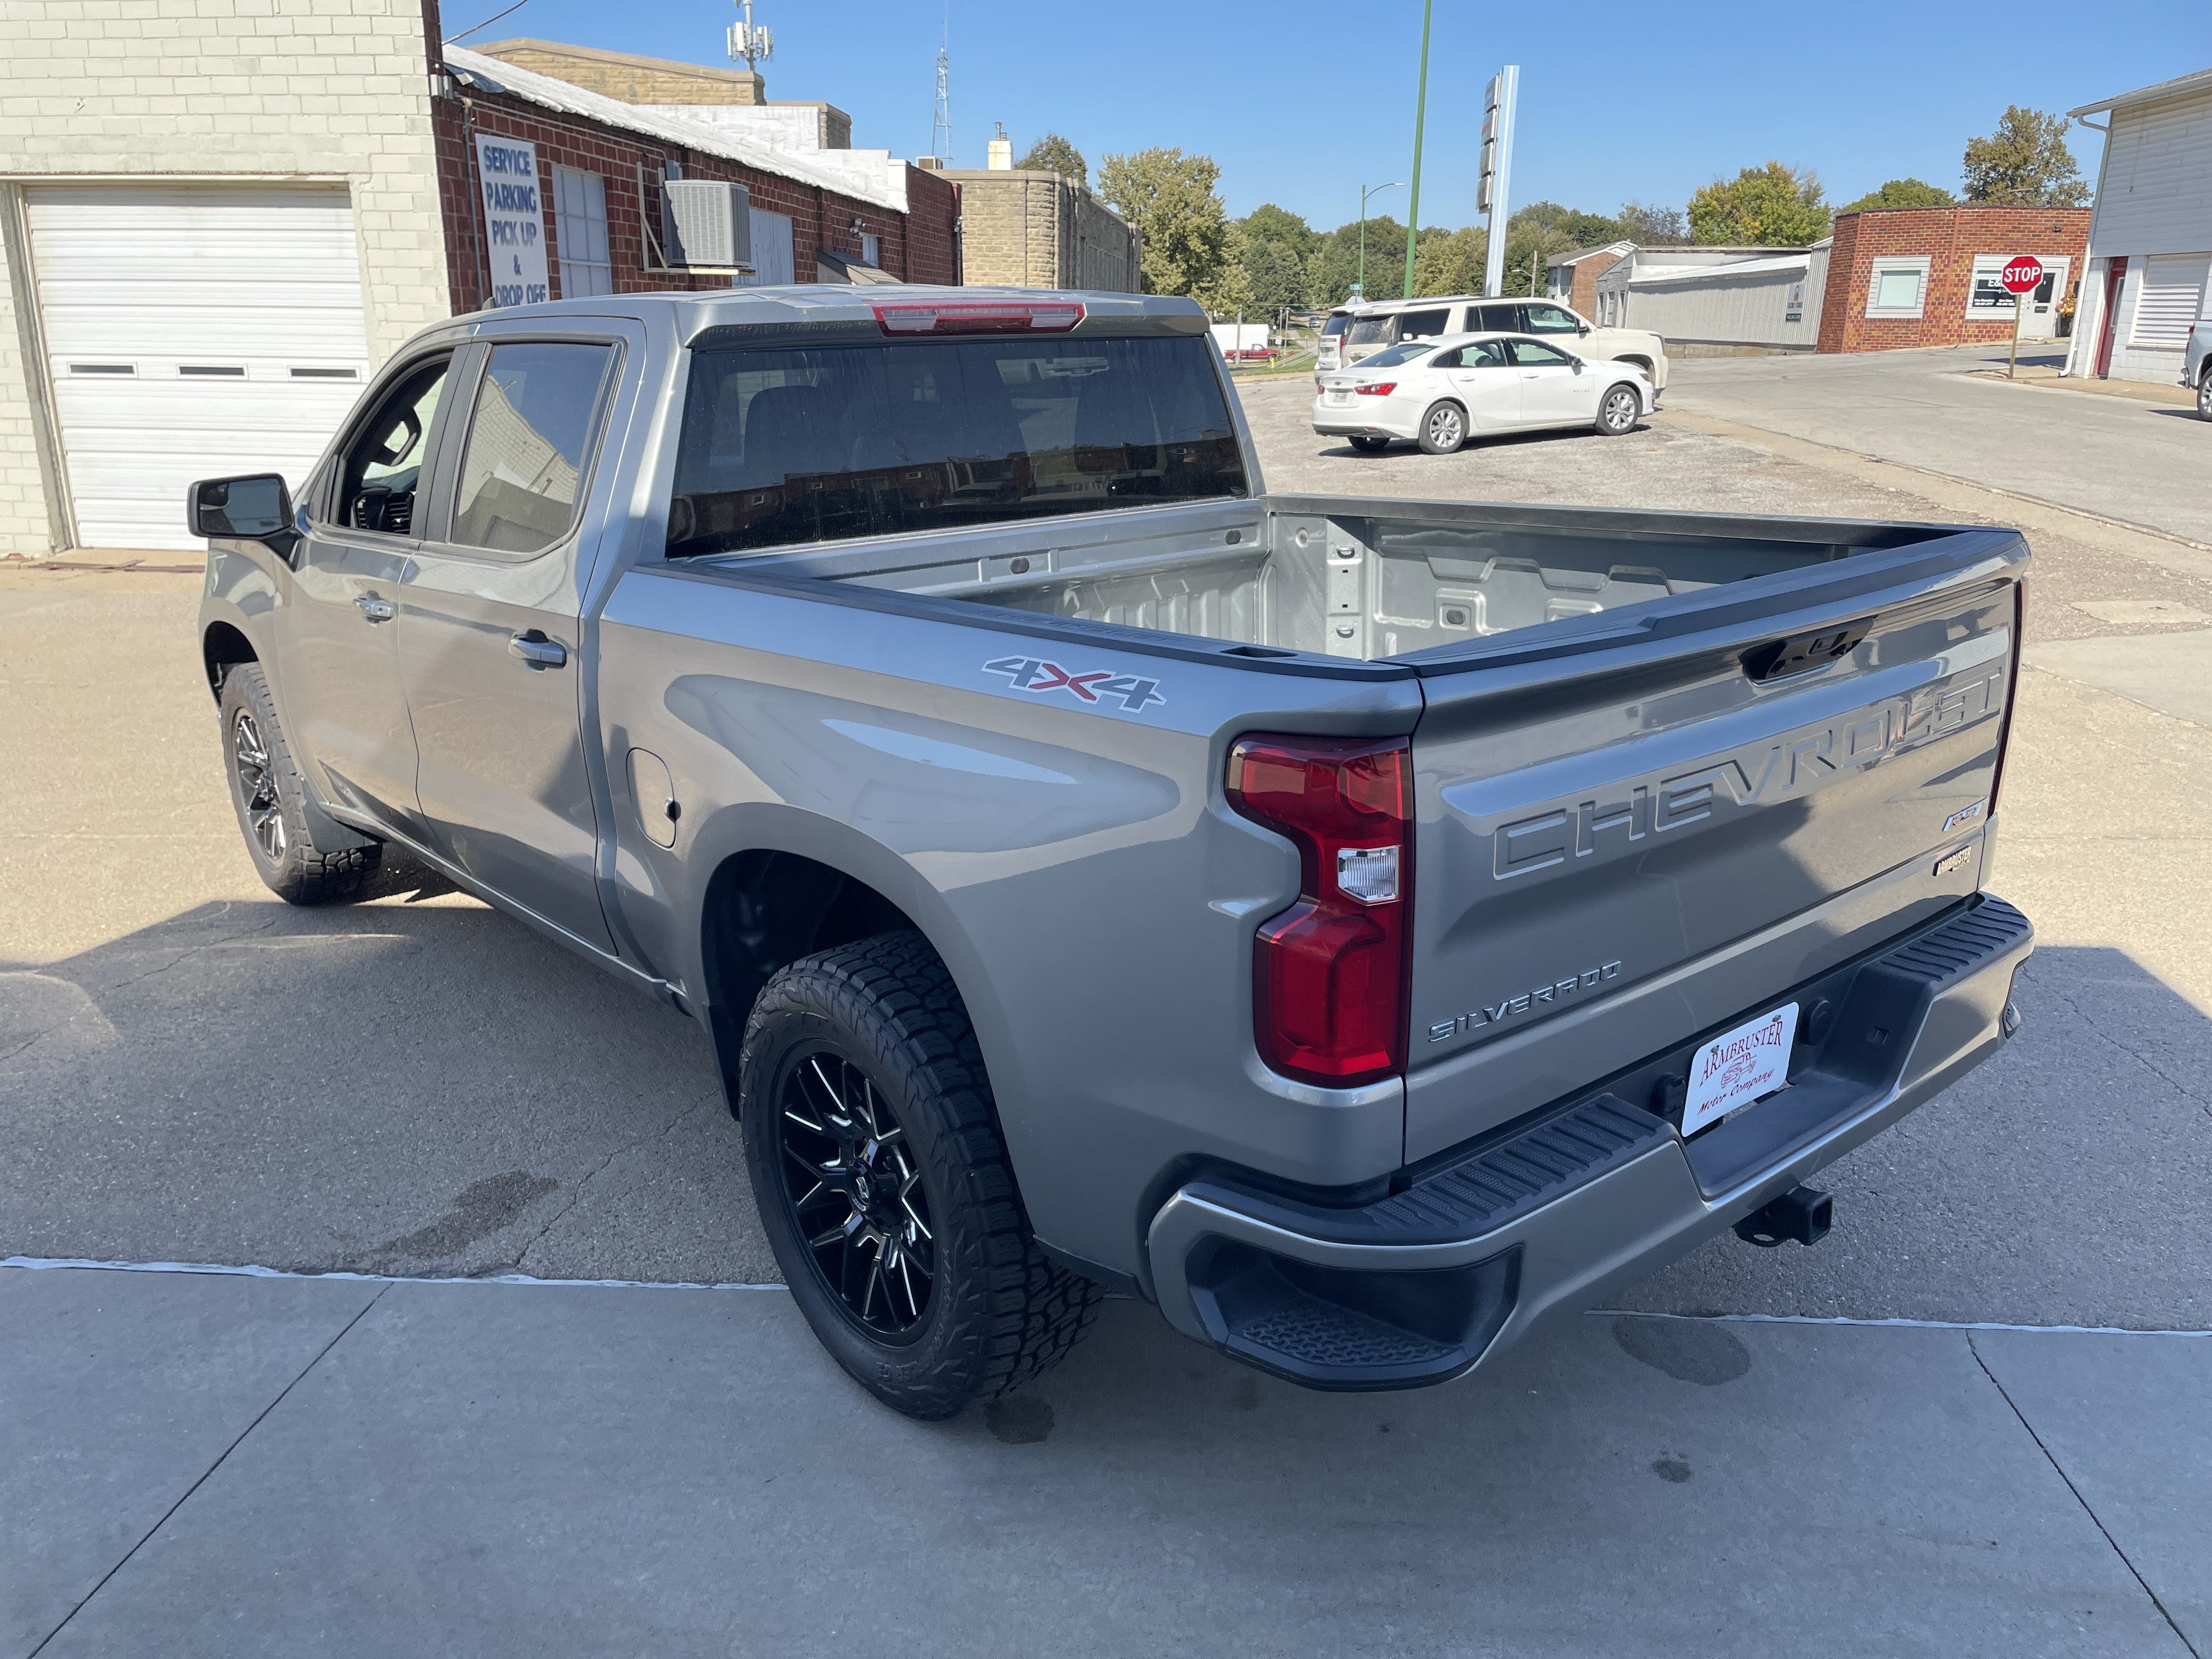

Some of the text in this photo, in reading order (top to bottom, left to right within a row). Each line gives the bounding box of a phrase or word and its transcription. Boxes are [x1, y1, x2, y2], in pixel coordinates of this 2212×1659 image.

[483, 145, 532, 176] SERVICE
[485, 181, 537, 213] PARKING
[492, 219, 537, 246] PICK UP
[514, 254, 522, 275] &
[2004, 267, 2041, 283] STOP
[495, 284, 546, 308] DROP OFF
[1988, 279, 2001, 287] E&
[1494, 666, 2001, 881] CHEVROLET
[1429, 960, 1622, 1042] SILVERADO
[1700, 1021, 1783, 1087] ARMBRUSTER
[1697, 1067, 1775, 1115] Motor Company
